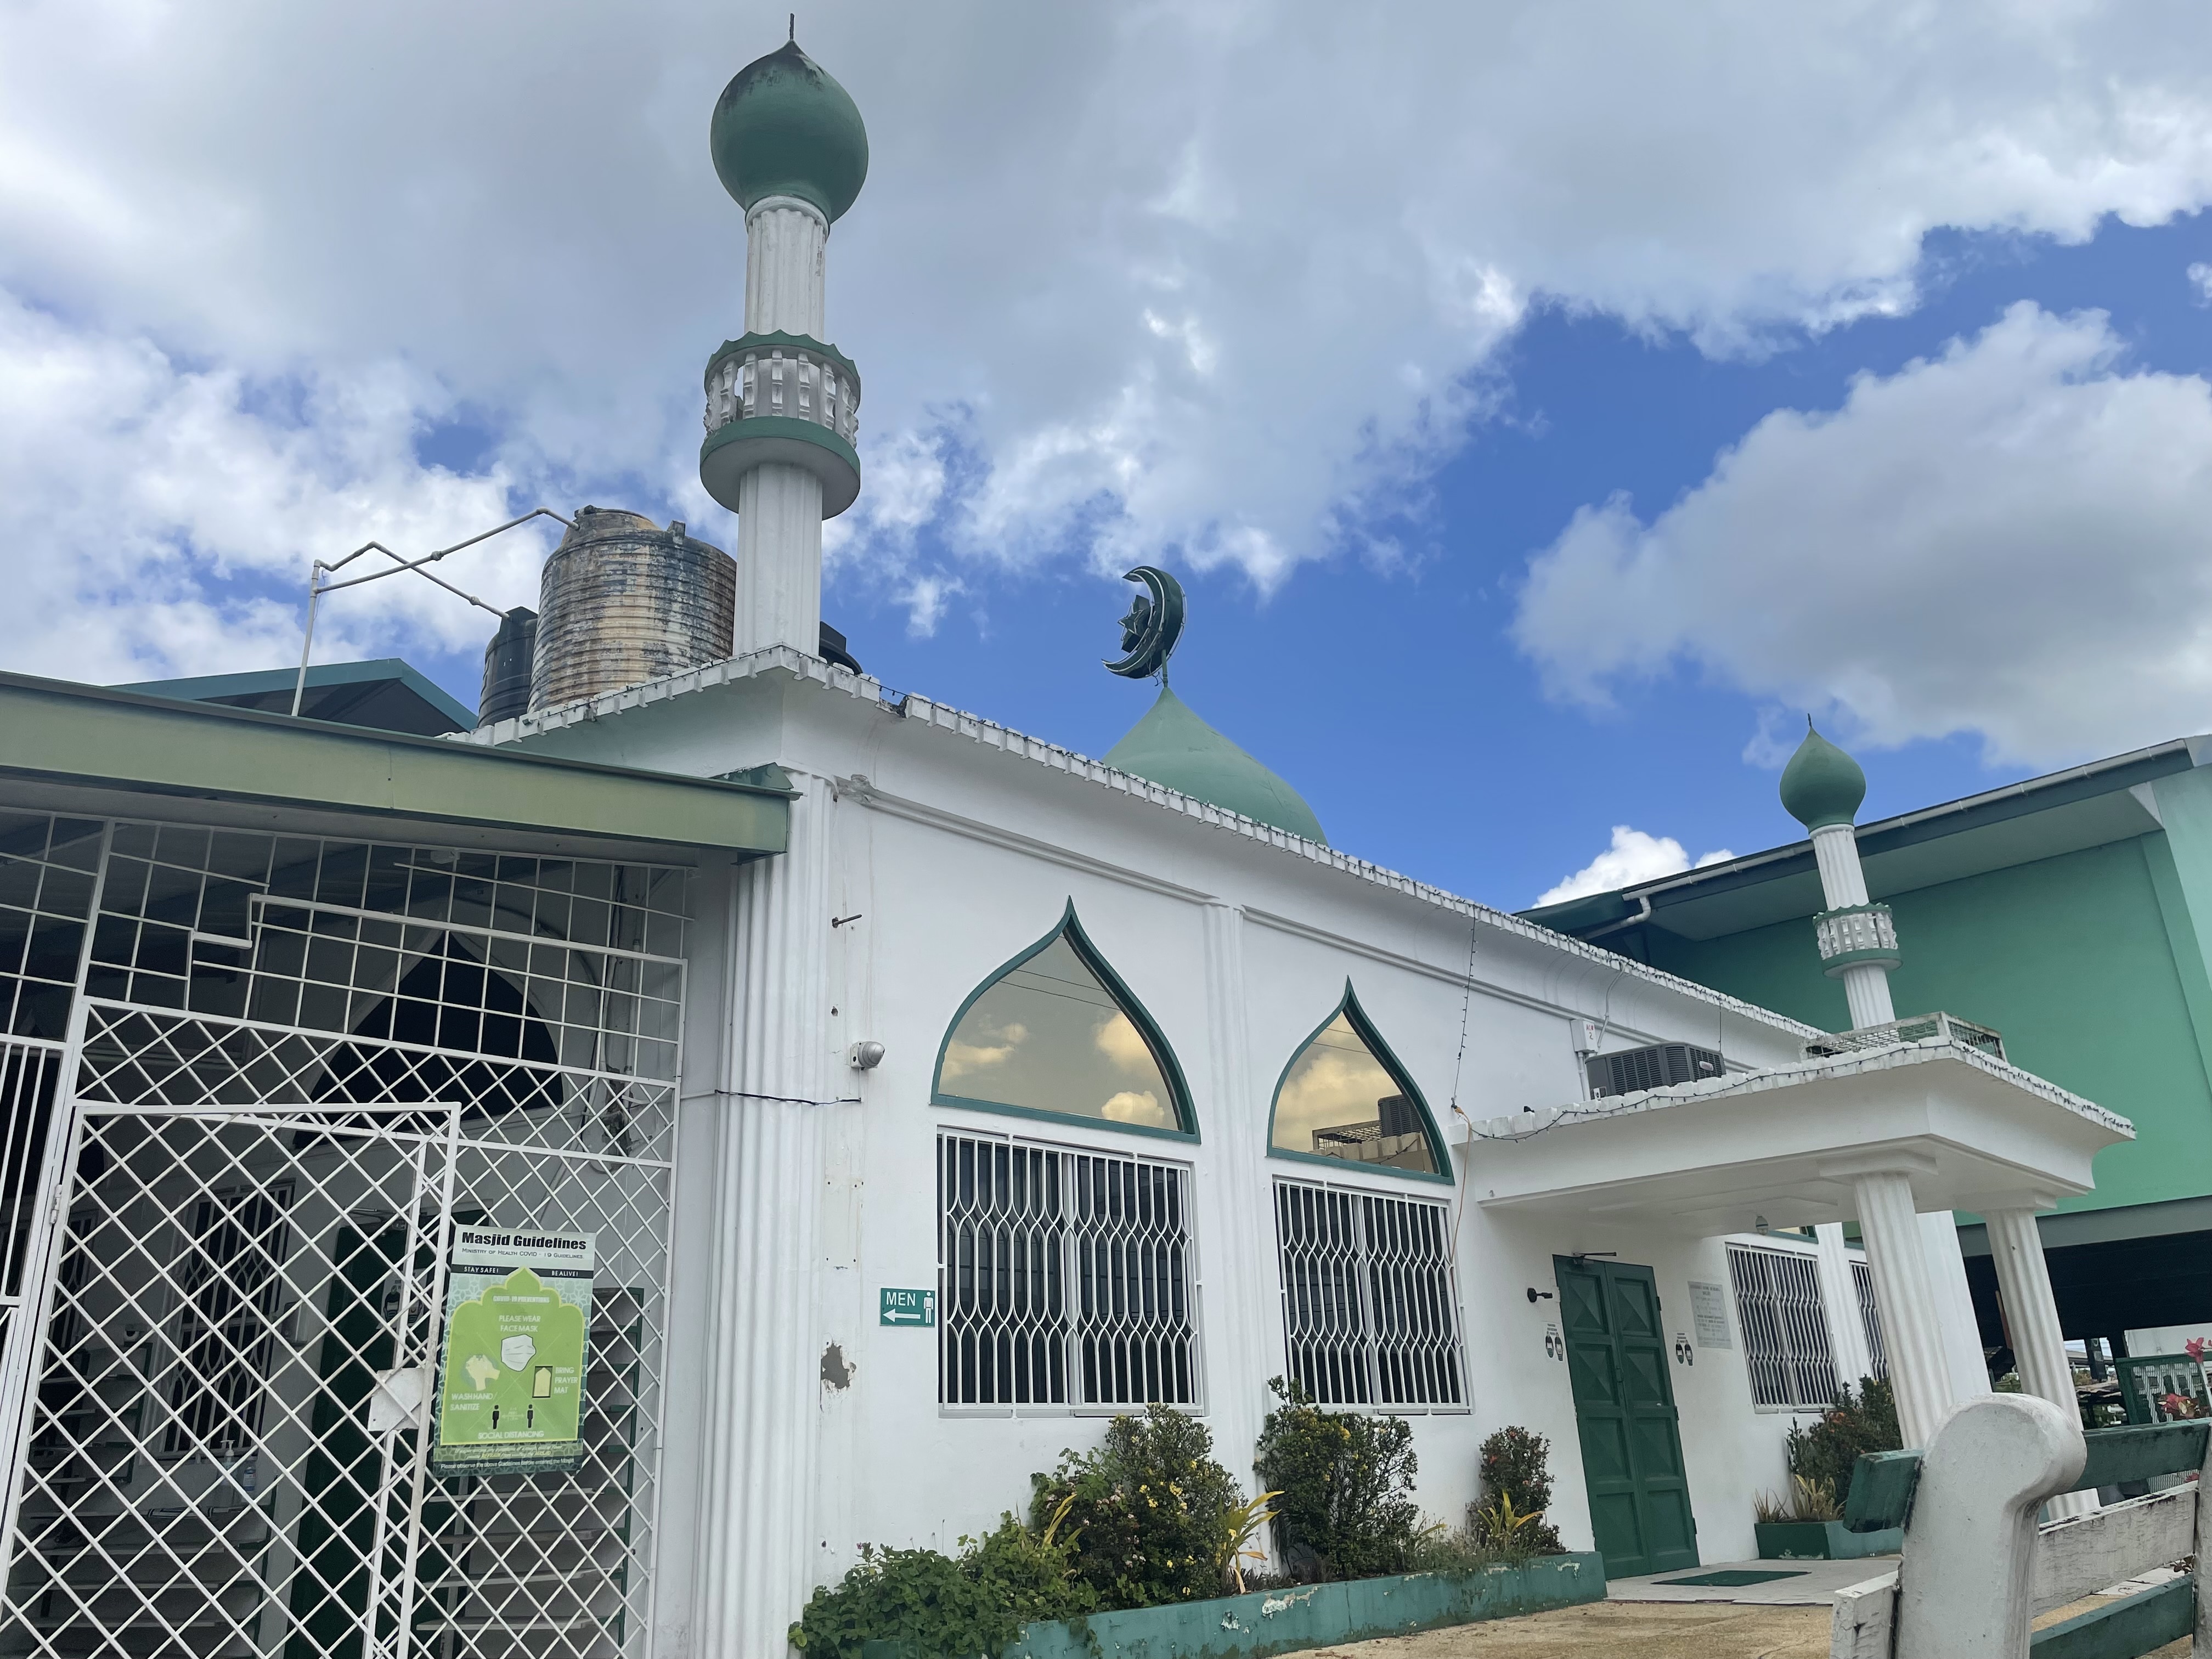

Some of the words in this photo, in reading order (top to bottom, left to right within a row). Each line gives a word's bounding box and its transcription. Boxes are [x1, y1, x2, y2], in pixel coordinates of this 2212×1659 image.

[462, 1232, 510, 1246] Masjid
[513, 1235, 587, 1250] Guidelines
[886, 1291, 916, 1307] MEN
[504, 1430, 544, 1438] DISTANCING
